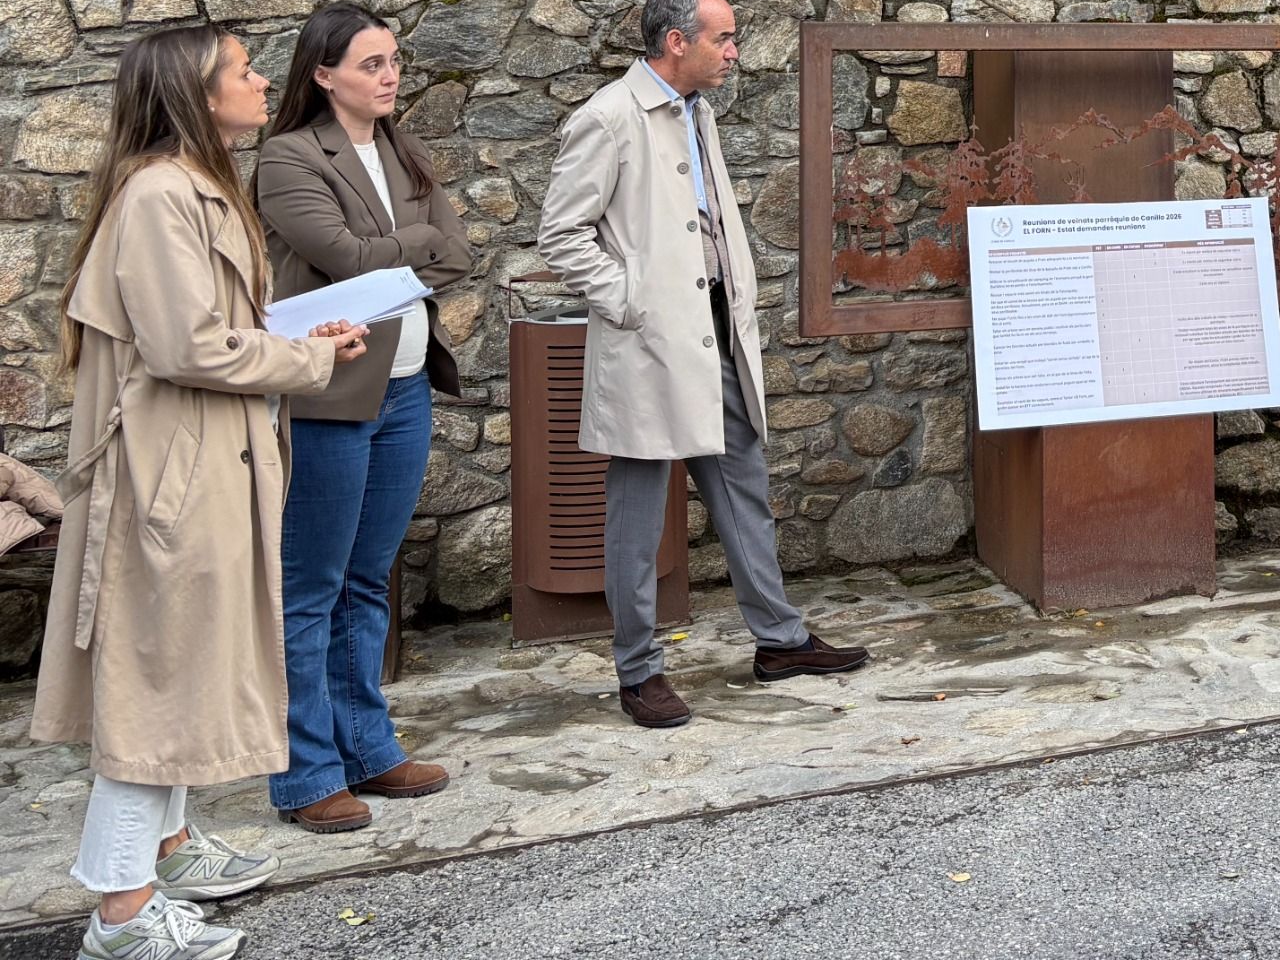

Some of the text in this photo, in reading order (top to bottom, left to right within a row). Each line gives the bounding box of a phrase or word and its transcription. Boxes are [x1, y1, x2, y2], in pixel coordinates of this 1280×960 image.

[1022, 219, 1055, 227] Reunions
[1057, 217, 1067, 225] de
[1131, 214, 1140, 222] de
[1140, 213, 1165, 222] Canillo
[1031, 227, 1052, 235] FORN
[1057, 225, 1076, 233] Estat
[1076, 225, 1114, 233] demandes
